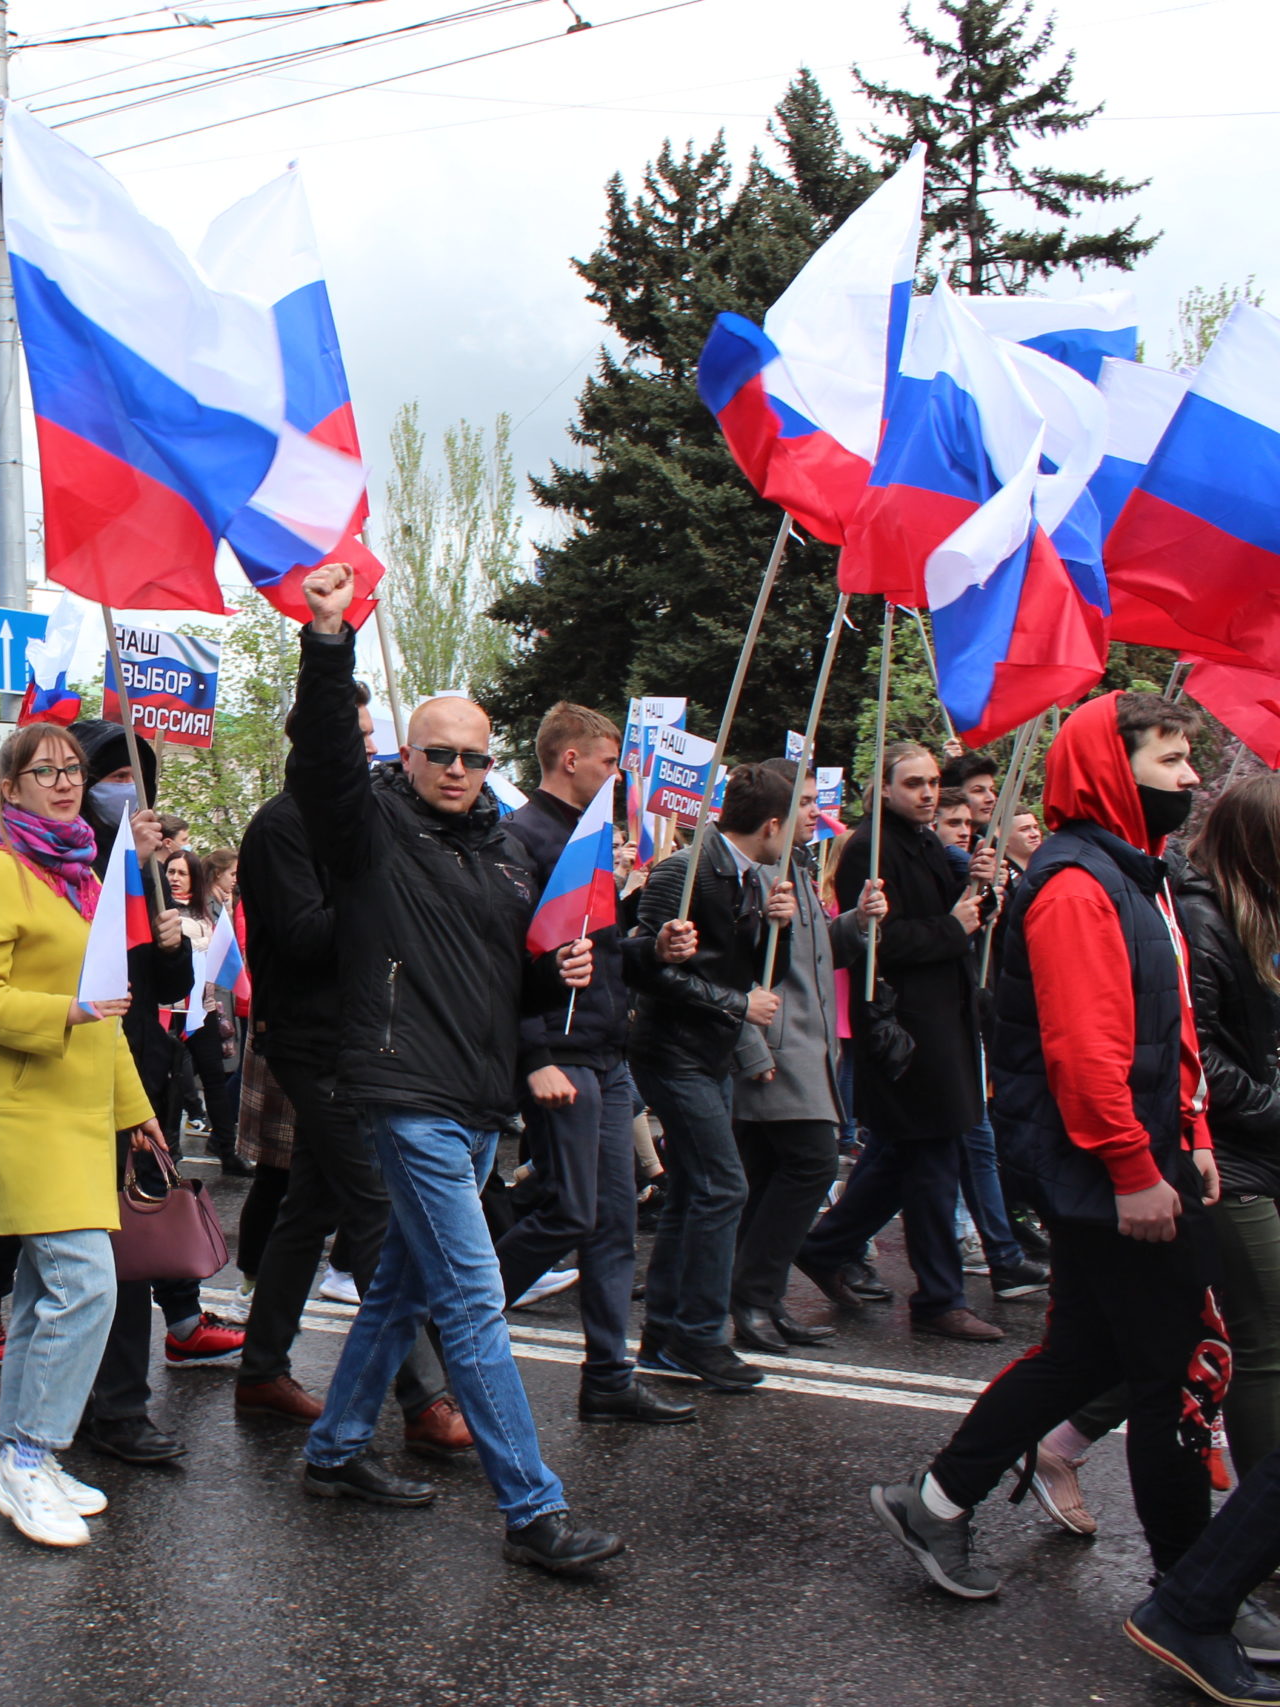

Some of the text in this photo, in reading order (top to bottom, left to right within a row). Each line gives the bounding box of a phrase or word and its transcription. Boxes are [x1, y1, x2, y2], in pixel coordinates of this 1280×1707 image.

[115, 628, 159, 655] НАШ
[120, 662, 192, 695] ВЫБОР
[131, 704, 210, 736] РОССИЯ!
[645, 703, 664, 719] НАШ
[660, 730, 687, 755] НАШ
[658, 760, 698, 789] ВЫБОР
[660, 789, 702, 818] РОССИЯ
